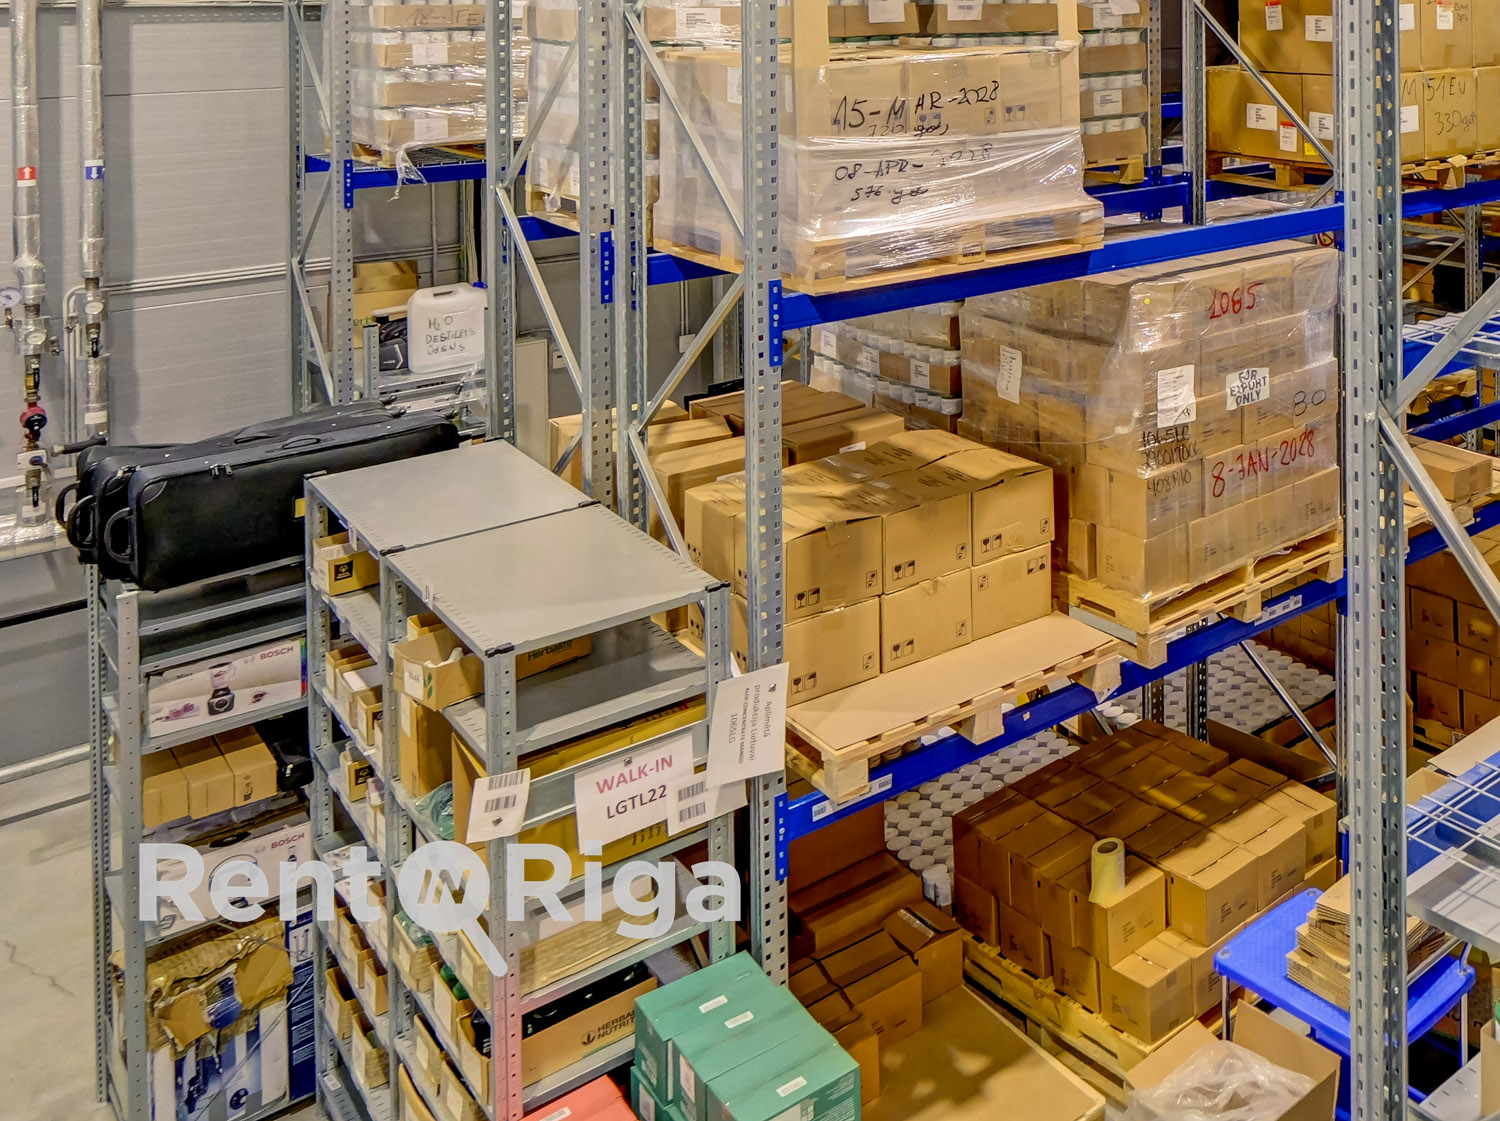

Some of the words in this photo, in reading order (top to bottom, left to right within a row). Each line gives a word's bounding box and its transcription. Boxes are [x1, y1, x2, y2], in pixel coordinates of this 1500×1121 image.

[1209, 283, 1264, 320] 1065
[1238, 369, 1258, 382] FOR
[1229, 376, 1268, 398] EXPORT
[1235, 390, 1262, 407] ONLY
[260, 646, 294, 660] BOSCH
[751, 684, 761, 727] produkcija
[749, 728, 758, 761] Lietuvai
[595, 754, 674, 794] WALK-IN
[606, 784, 668, 820] LGTL22
[271, 832, 305, 849] BOSCH
[597, 1010, 635, 1032] HERBA
[597, 1017, 635, 1040] NUTRIT
